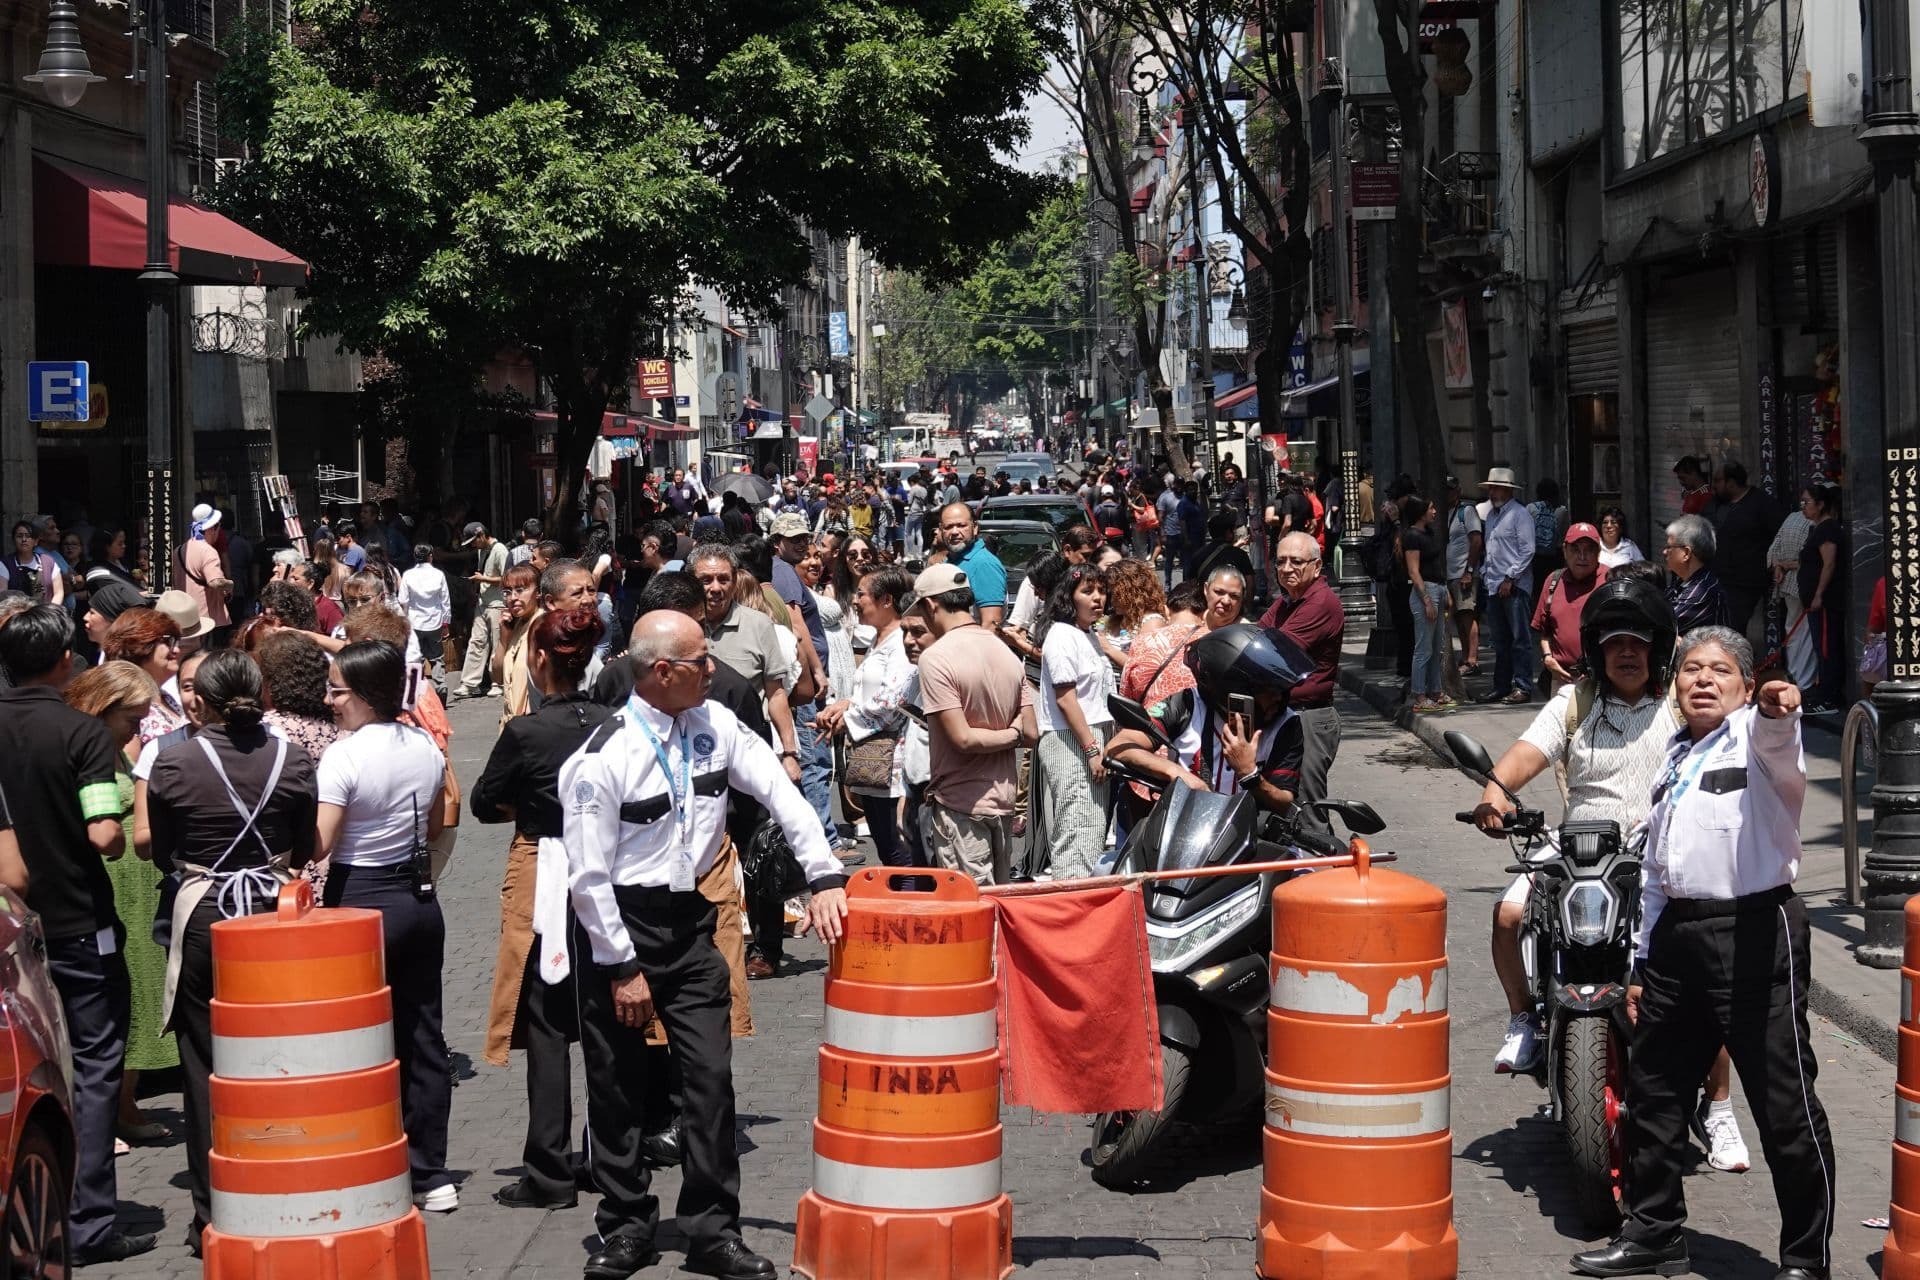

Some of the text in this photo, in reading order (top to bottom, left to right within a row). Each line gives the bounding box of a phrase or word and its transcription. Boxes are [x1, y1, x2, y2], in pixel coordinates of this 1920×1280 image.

[643, 376, 668, 386] DONCELES
[644, 361, 666, 374] WC
[1291, 355, 1306, 387] WC
[42, 371, 75, 412] E
[1761, 375, 1773, 495] ARTESANIAS
[871, 915, 964, 945] INBA
[870, 1065, 961, 1095] INBA
